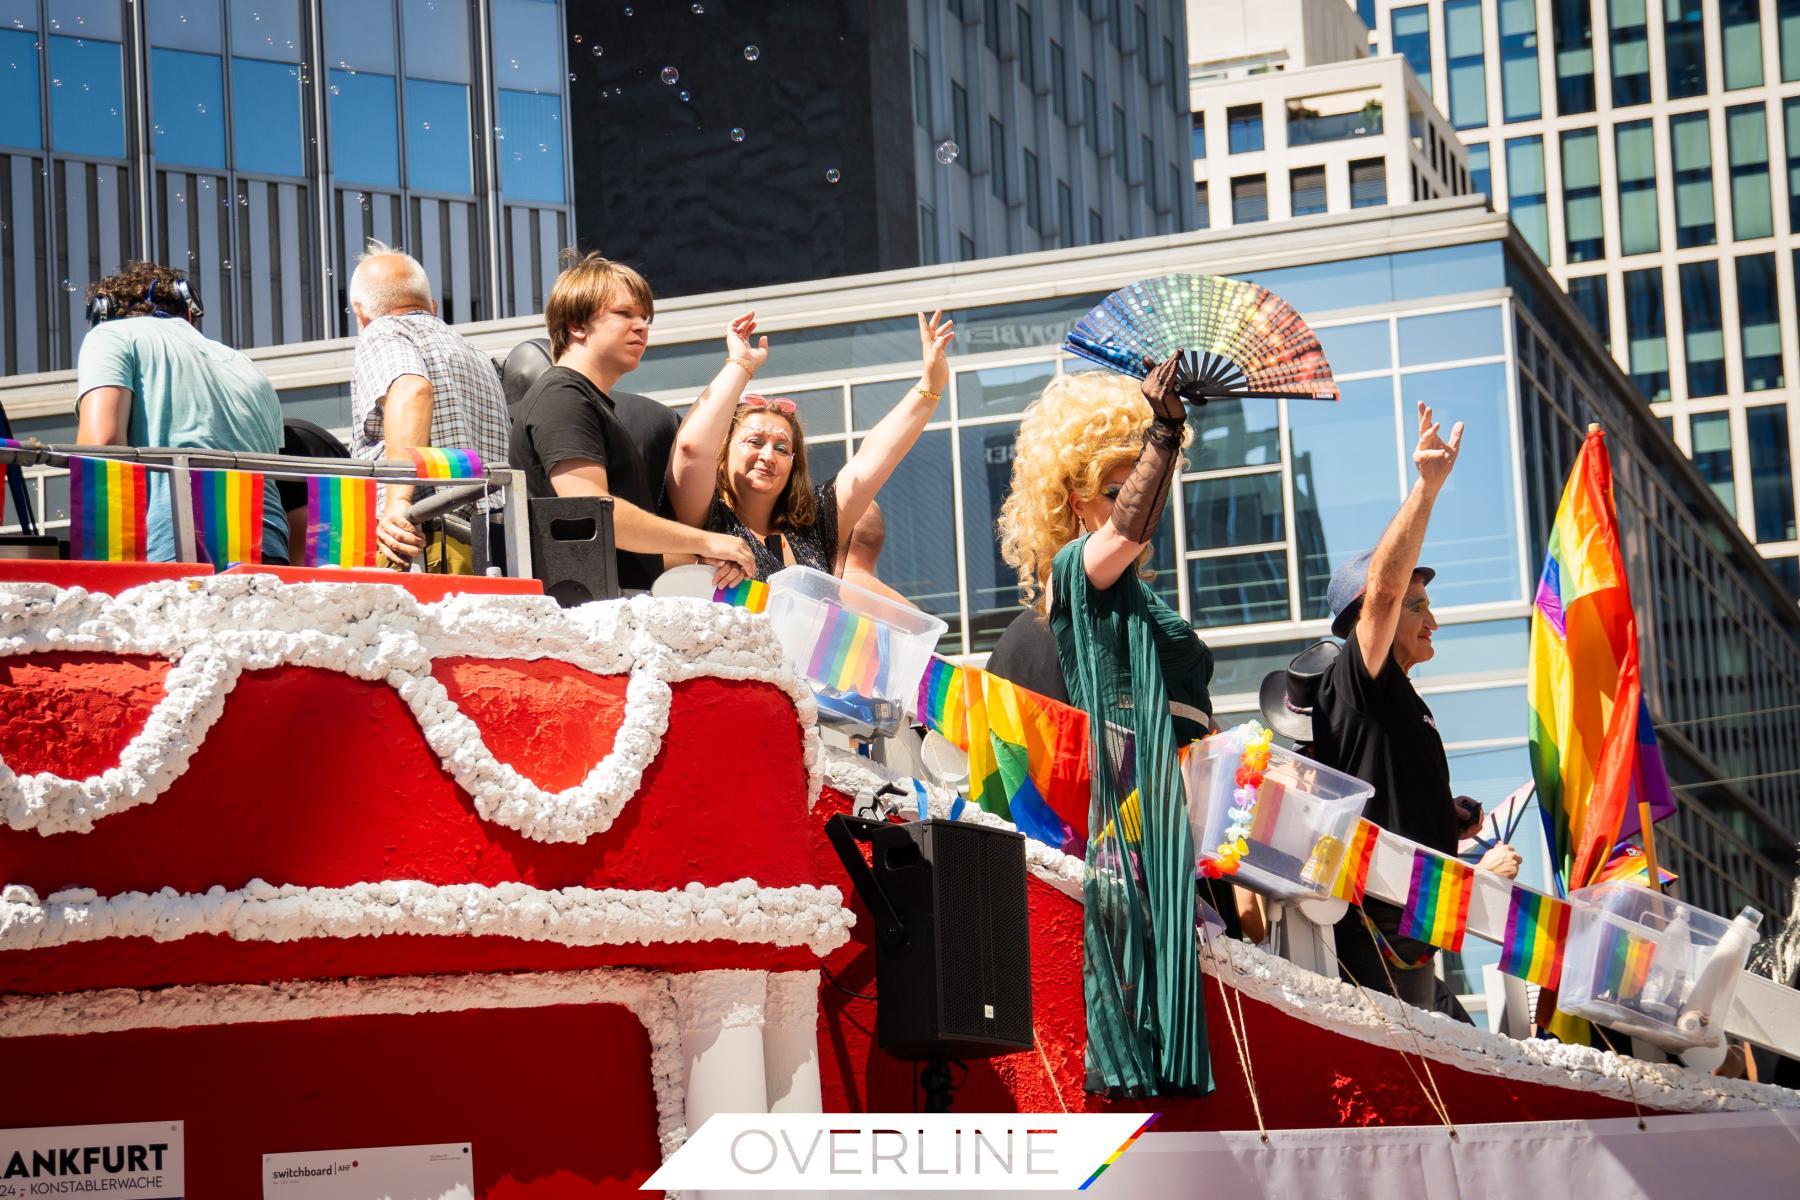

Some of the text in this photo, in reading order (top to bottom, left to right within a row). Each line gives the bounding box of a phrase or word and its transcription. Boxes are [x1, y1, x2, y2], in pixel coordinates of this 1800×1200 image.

[0, 1143, 168, 1179] ANKFURT
[272, 1164, 351, 1179] switchboard AHF
[30, 1175, 163, 1195] KONSTABLERWACHE
